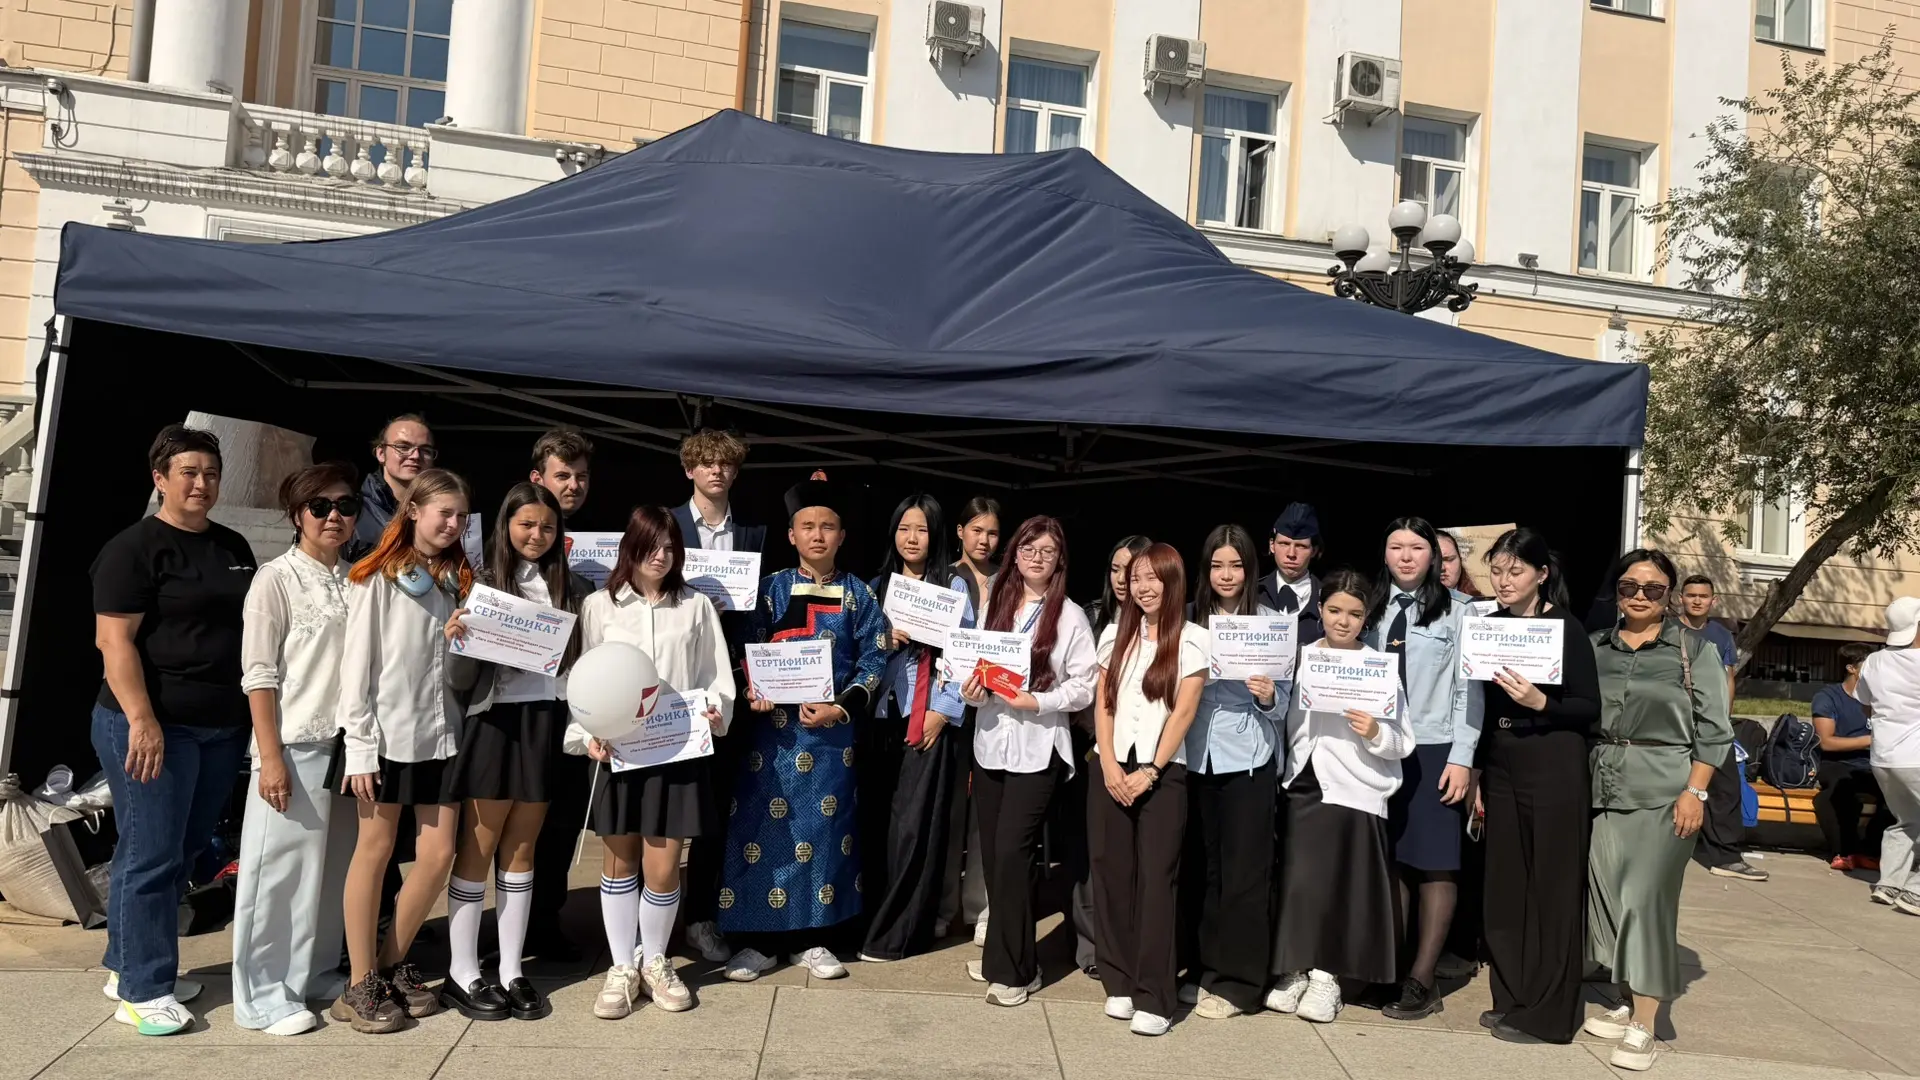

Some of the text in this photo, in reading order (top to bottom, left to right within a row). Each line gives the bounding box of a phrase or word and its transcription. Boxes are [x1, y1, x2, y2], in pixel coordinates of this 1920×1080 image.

[571, 549, 619, 558] ИФИКАТ
[684, 563, 750, 576] ЕРТИФИКАТ
[893, 590, 956, 614] СЕРТИФИКАТ
[473, 604, 561, 636] СЕРТИФИКАТ
[1218, 632, 1289, 642] СЕРТИФИКАТ
[1471, 632, 1552, 645] СЕРТИФИКАТ
[952, 640, 1022, 654] СЕРТИФИКАТ
[755, 656, 822, 668] СЕРТИФИКАТ
[1310, 664, 1388, 678] СЕРТИФИКАТ
[645, 707, 696, 725] ИФИКАТ
